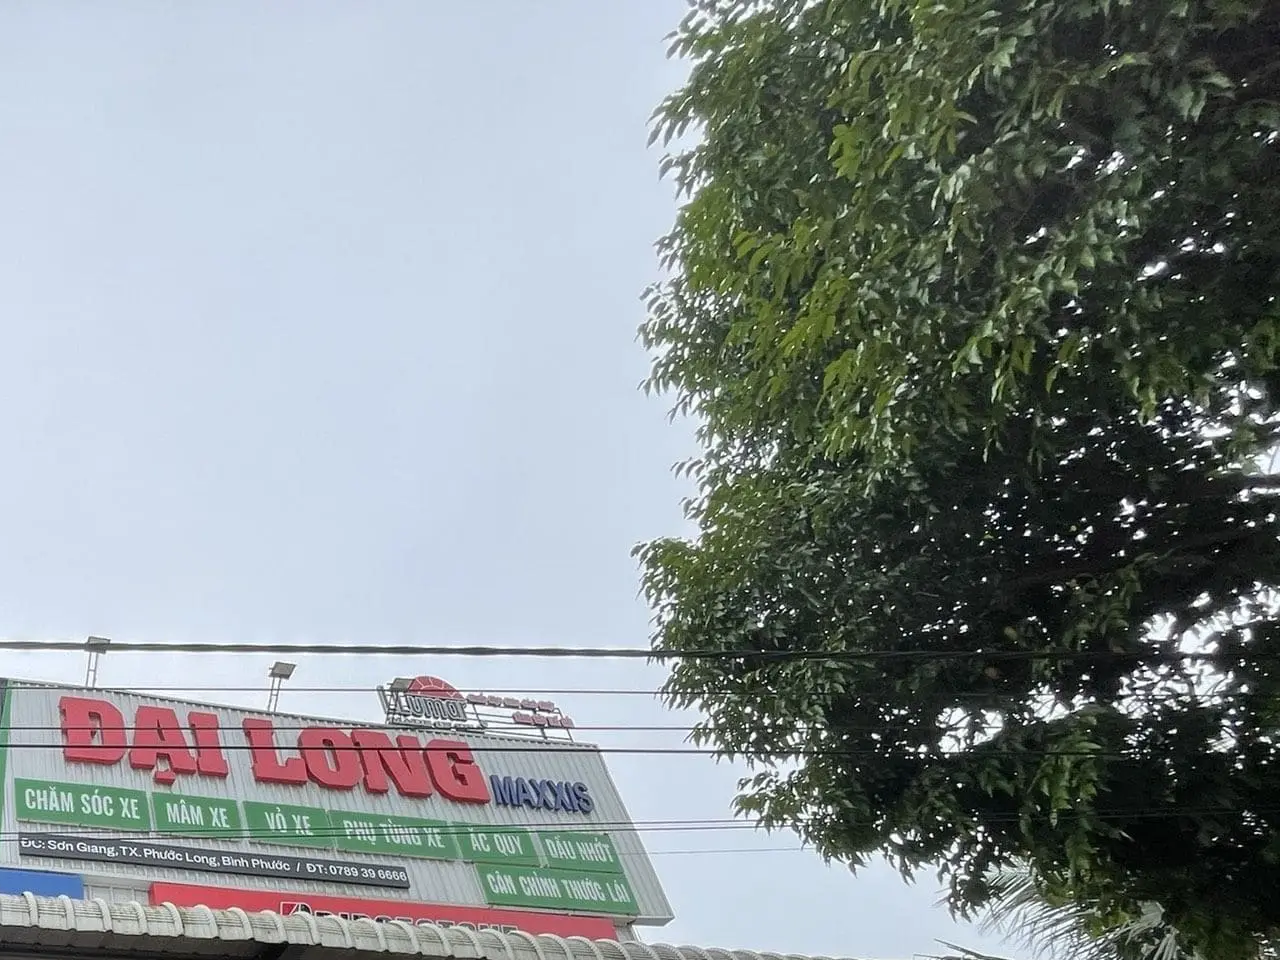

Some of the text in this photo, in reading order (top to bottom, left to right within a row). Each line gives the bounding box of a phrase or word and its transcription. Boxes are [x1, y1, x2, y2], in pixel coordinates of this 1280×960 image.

[59, 696, 490, 804] ĐẠI LONG
[24, 785, 141, 820] CHĂM SÓC XE
[490, 775, 595, 814] MAXXIS
[166, 799, 231, 828] MÂM XE
[264, 808, 314, 836] VỎ XE
[342, 818, 446, 848] PHỤ TÙNG XE
[492, 833, 524, 857] QUY
[544, 835, 614, 862] DẦU NHỚT
[47, 840, 74, 852] Sơn
[119, 847, 142, 858] TX.
[144, 848, 184, 863] Phước
[186, 852, 220, 868] Long,
[221, 855, 249, 869] Bình
[252, 857, 291, 872] Phước
[306, 864, 329, 875] ĐT:
[331, 865, 358, 878] 0789
[361, 868, 376, 880] 39
[379, 870, 407, 885] 6666
[486, 871, 519, 895] CÂN
[560, 878, 608, 901] THƯỚC
[605, 882, 631, 903] LÁI
